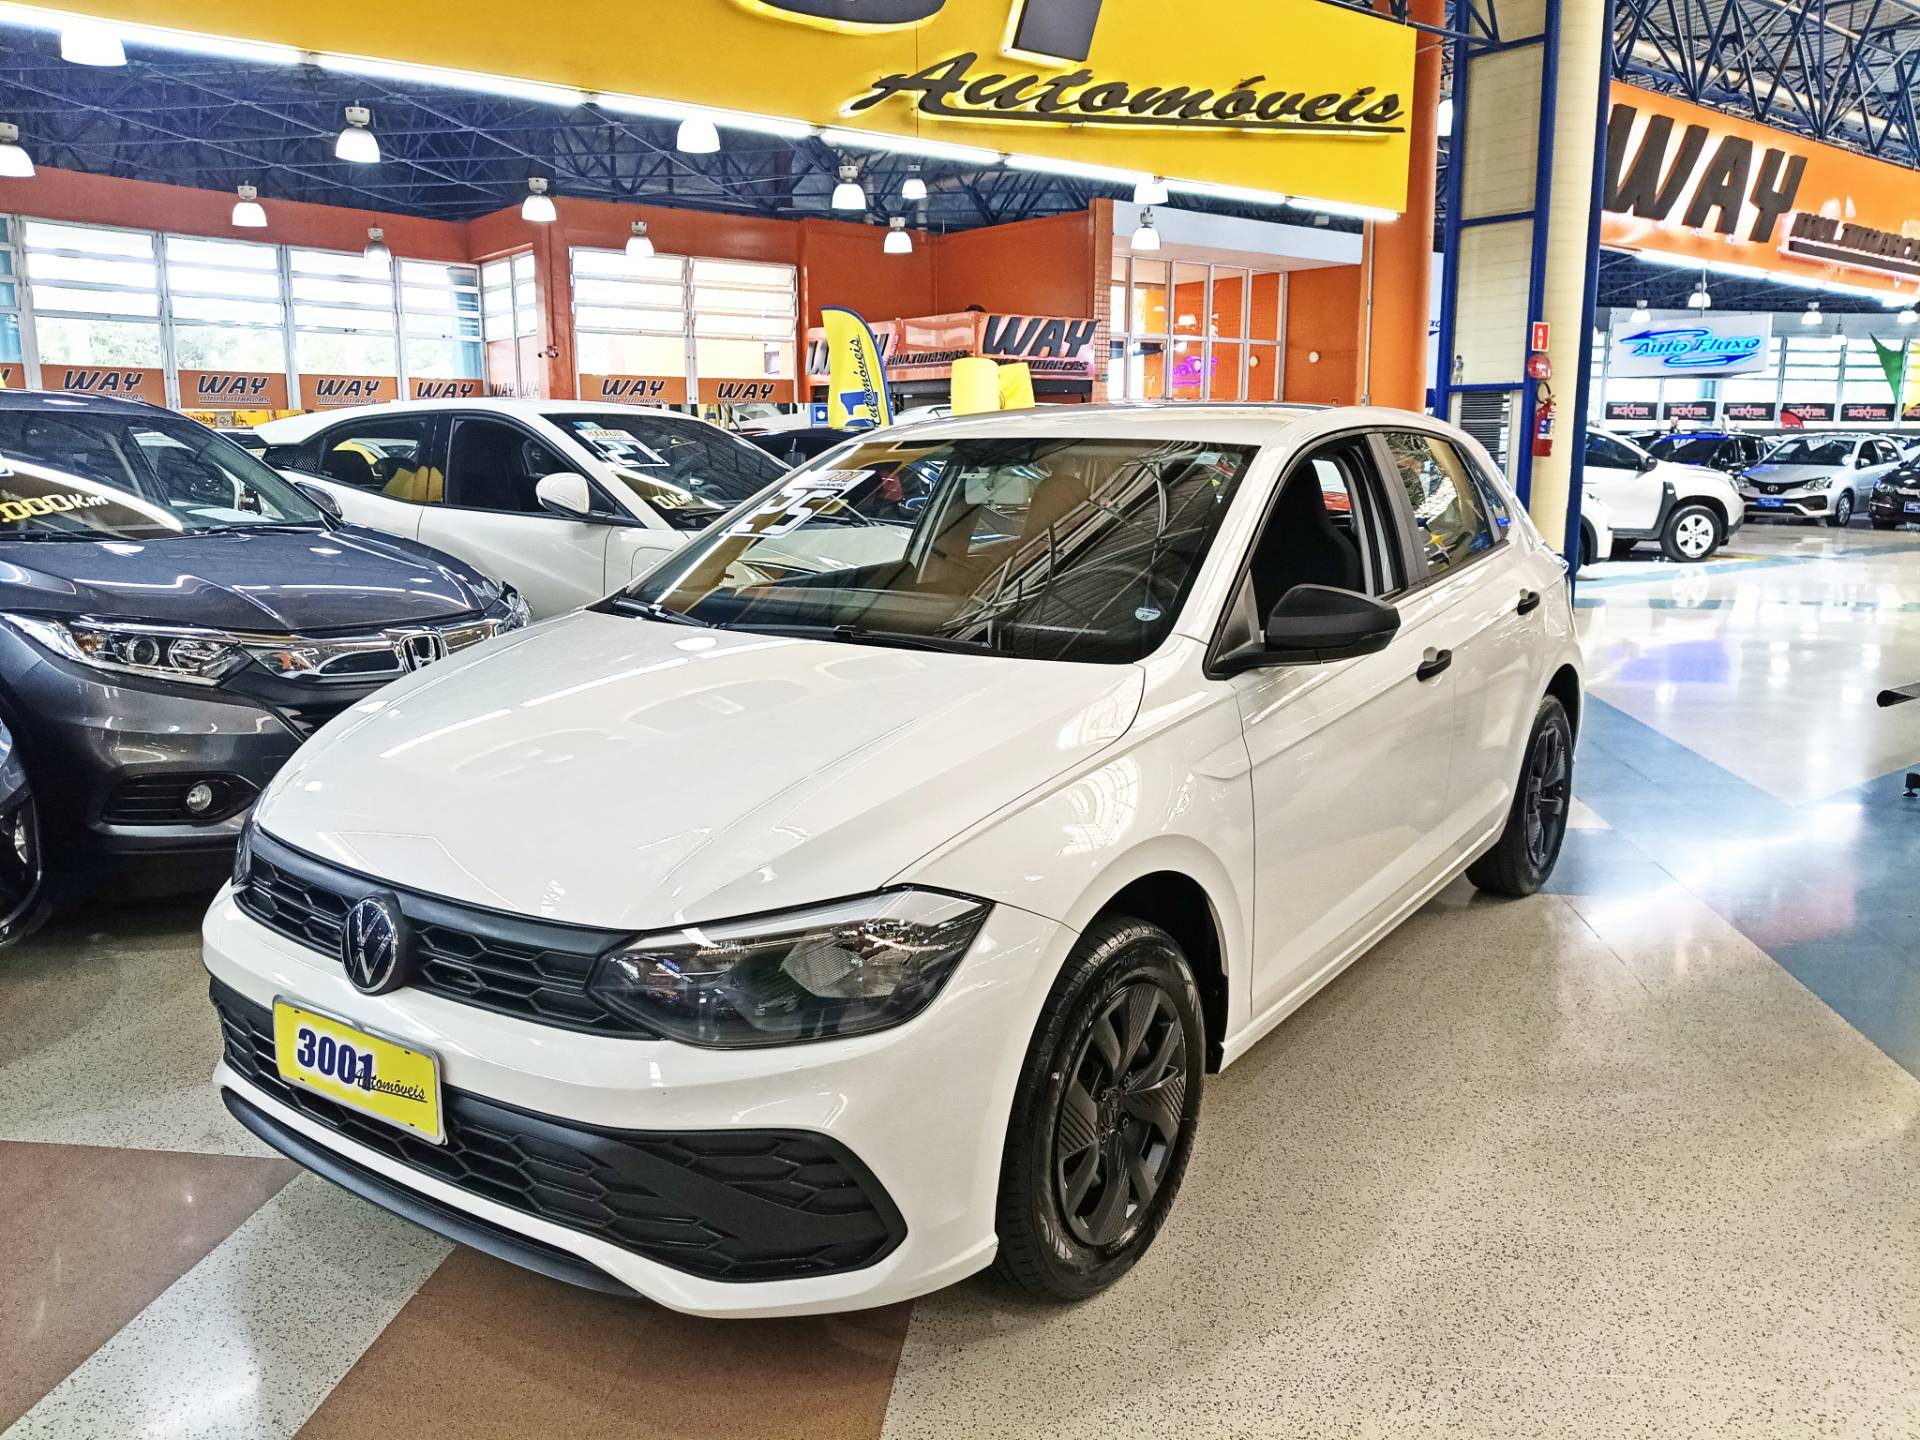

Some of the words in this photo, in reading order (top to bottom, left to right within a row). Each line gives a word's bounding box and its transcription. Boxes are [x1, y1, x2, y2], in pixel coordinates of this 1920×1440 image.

[850, 52, 1405, 127] Automóveis
[1602, 103, 1808, 243] WAY
[983, 315, 1098, 358] WAY
[1632, 340, 1688, 356] Auto
[1693, 337, 1762, 352] Fluxo
[63, 368, 145, 392] WAY
[198, 374, 269, 395] WAY
[316, 378, 381, 397] WAY
[416, 381, 474, 399] WAY
[602, 378, 665, 396] WAY
[717, 381, 774, 399] WAY
[297, 1028, 373, 1092] 3001
